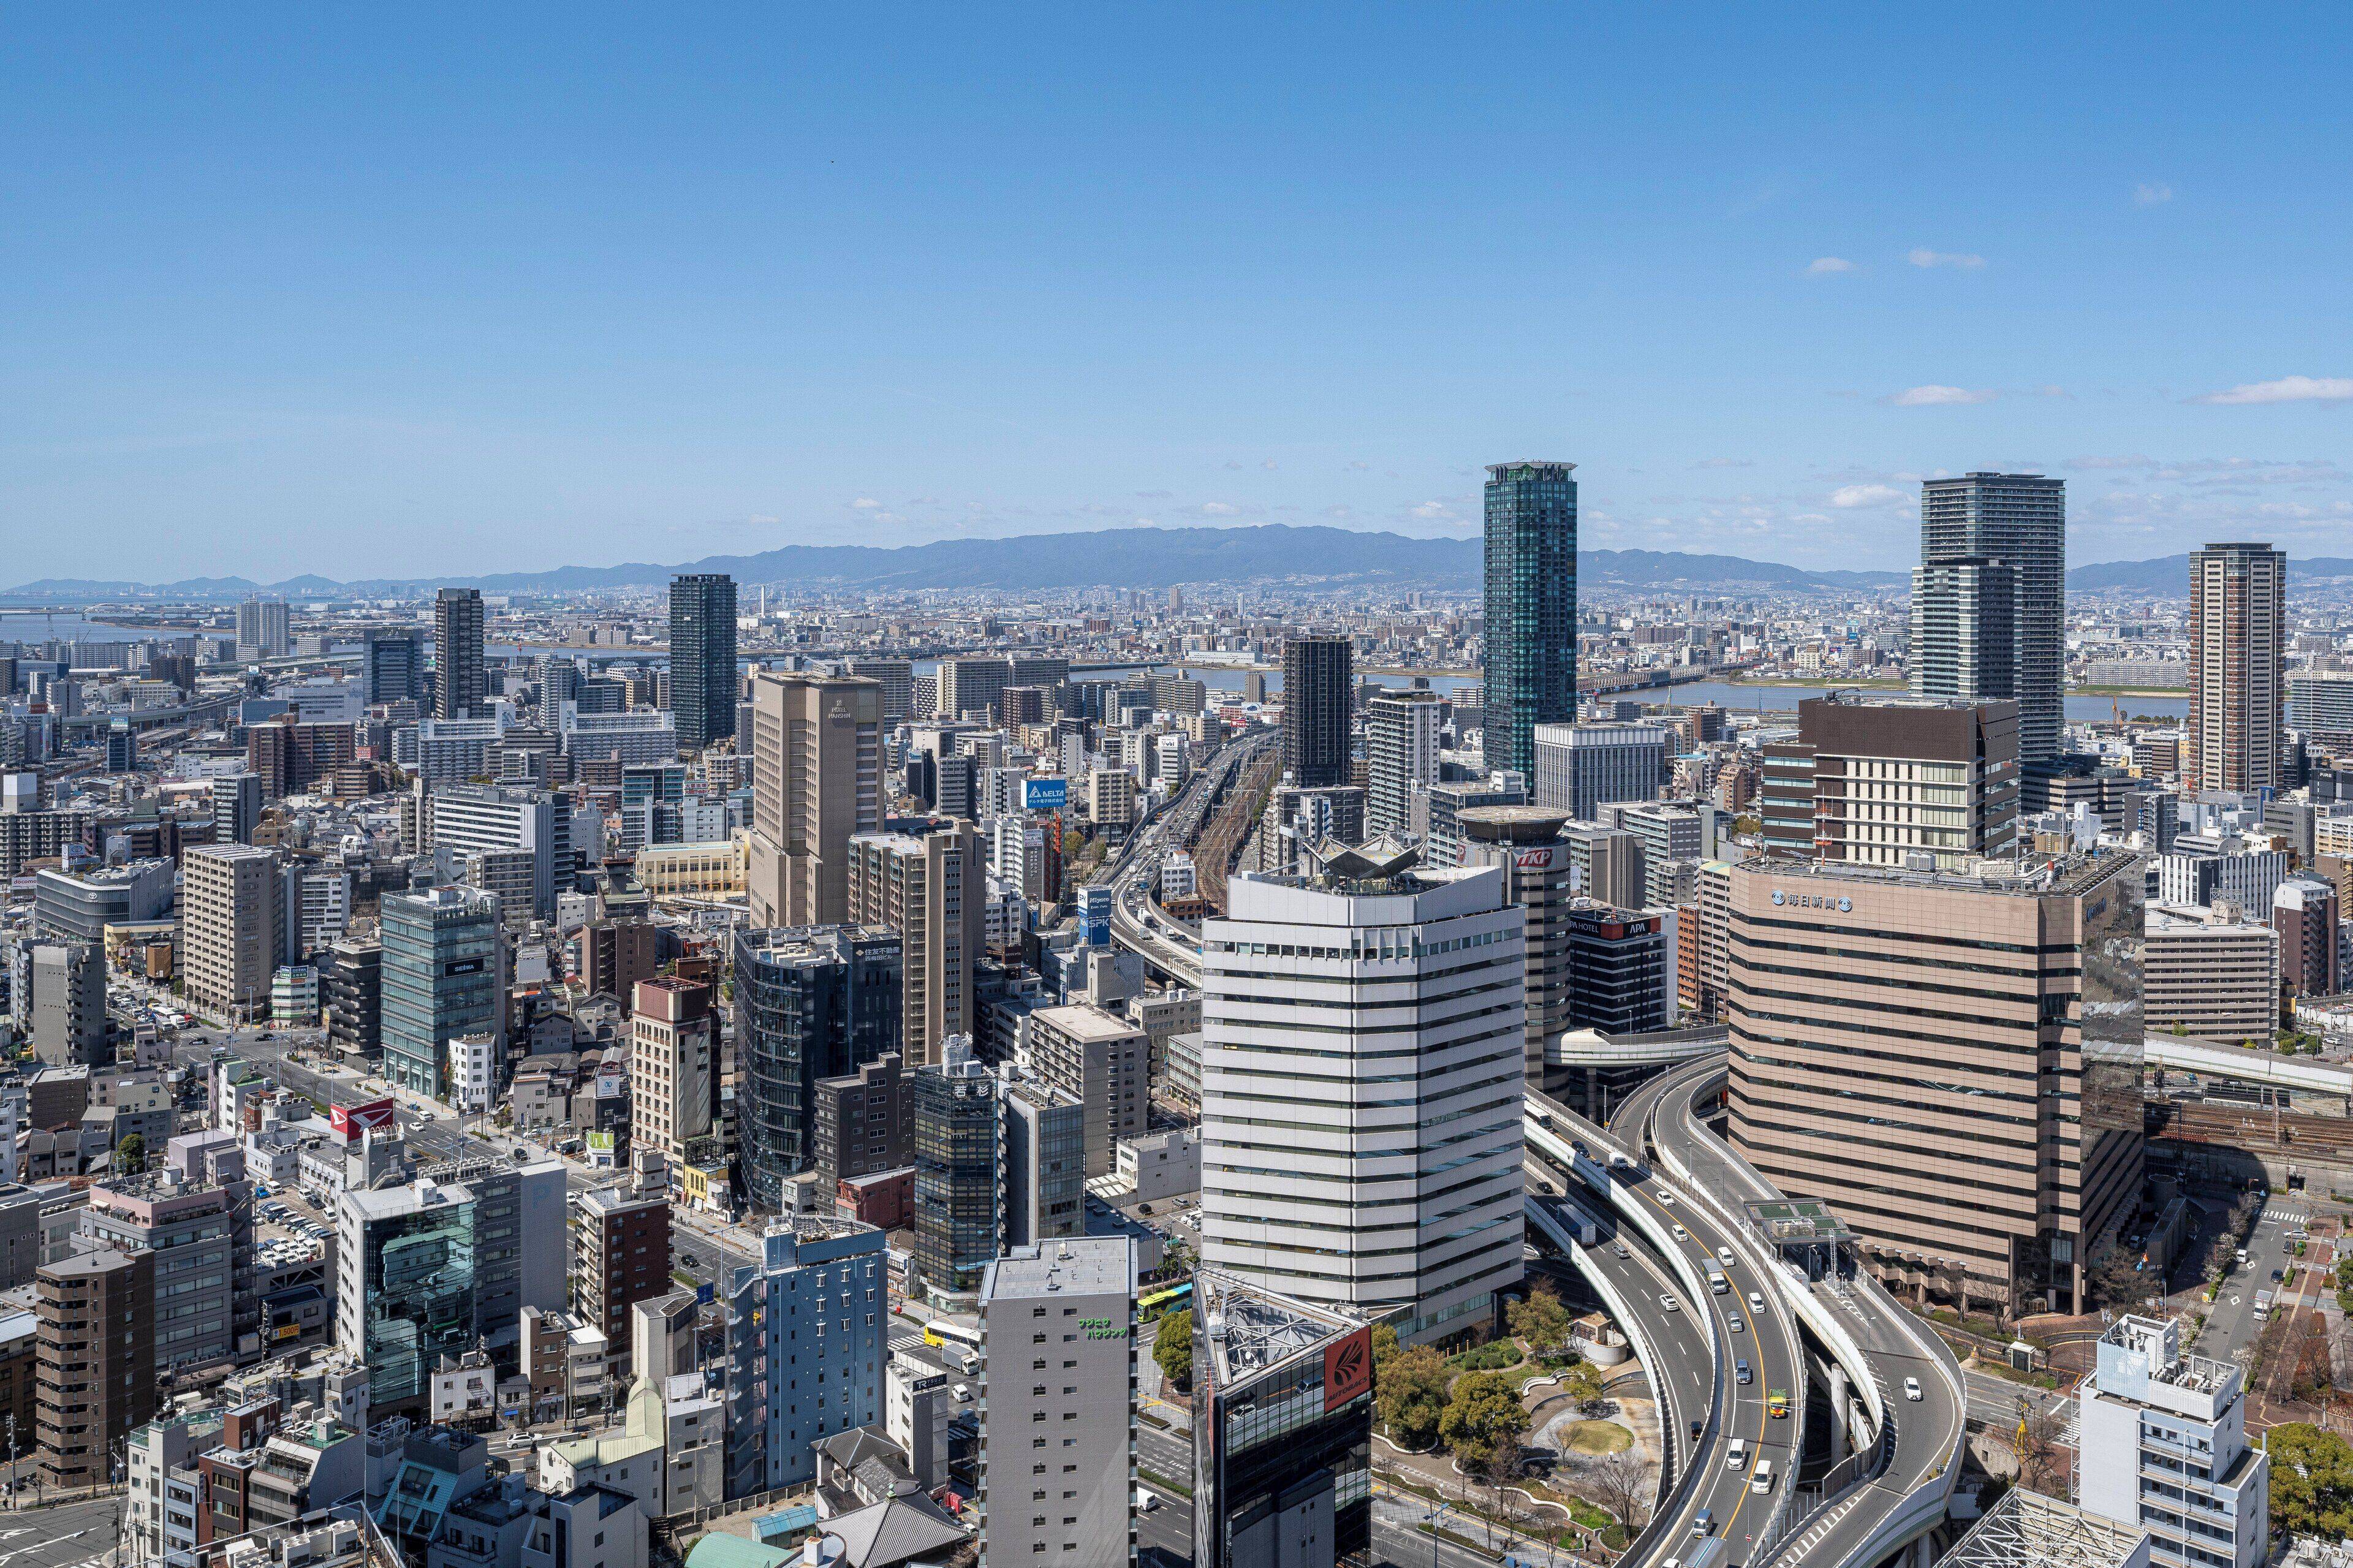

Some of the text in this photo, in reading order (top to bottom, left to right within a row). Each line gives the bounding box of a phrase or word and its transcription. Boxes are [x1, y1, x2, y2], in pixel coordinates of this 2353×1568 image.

[1520, 850, 1550, 865] TKP
[1787, 893, 1836, 910] 毎日新聞
[1089, 918, 1110, 928] SPK
[1578, 922, 1599, 933] HOTEL
[1630, 923, 1646, 934] APA
[865, 946, 900, 956] 住友不動産
[954, 1084, 989, 1097] 若杉
[279, 1325, 299, 1338] 1,500円
[1327, 1376, 1368, 1403] AUTOBACS
